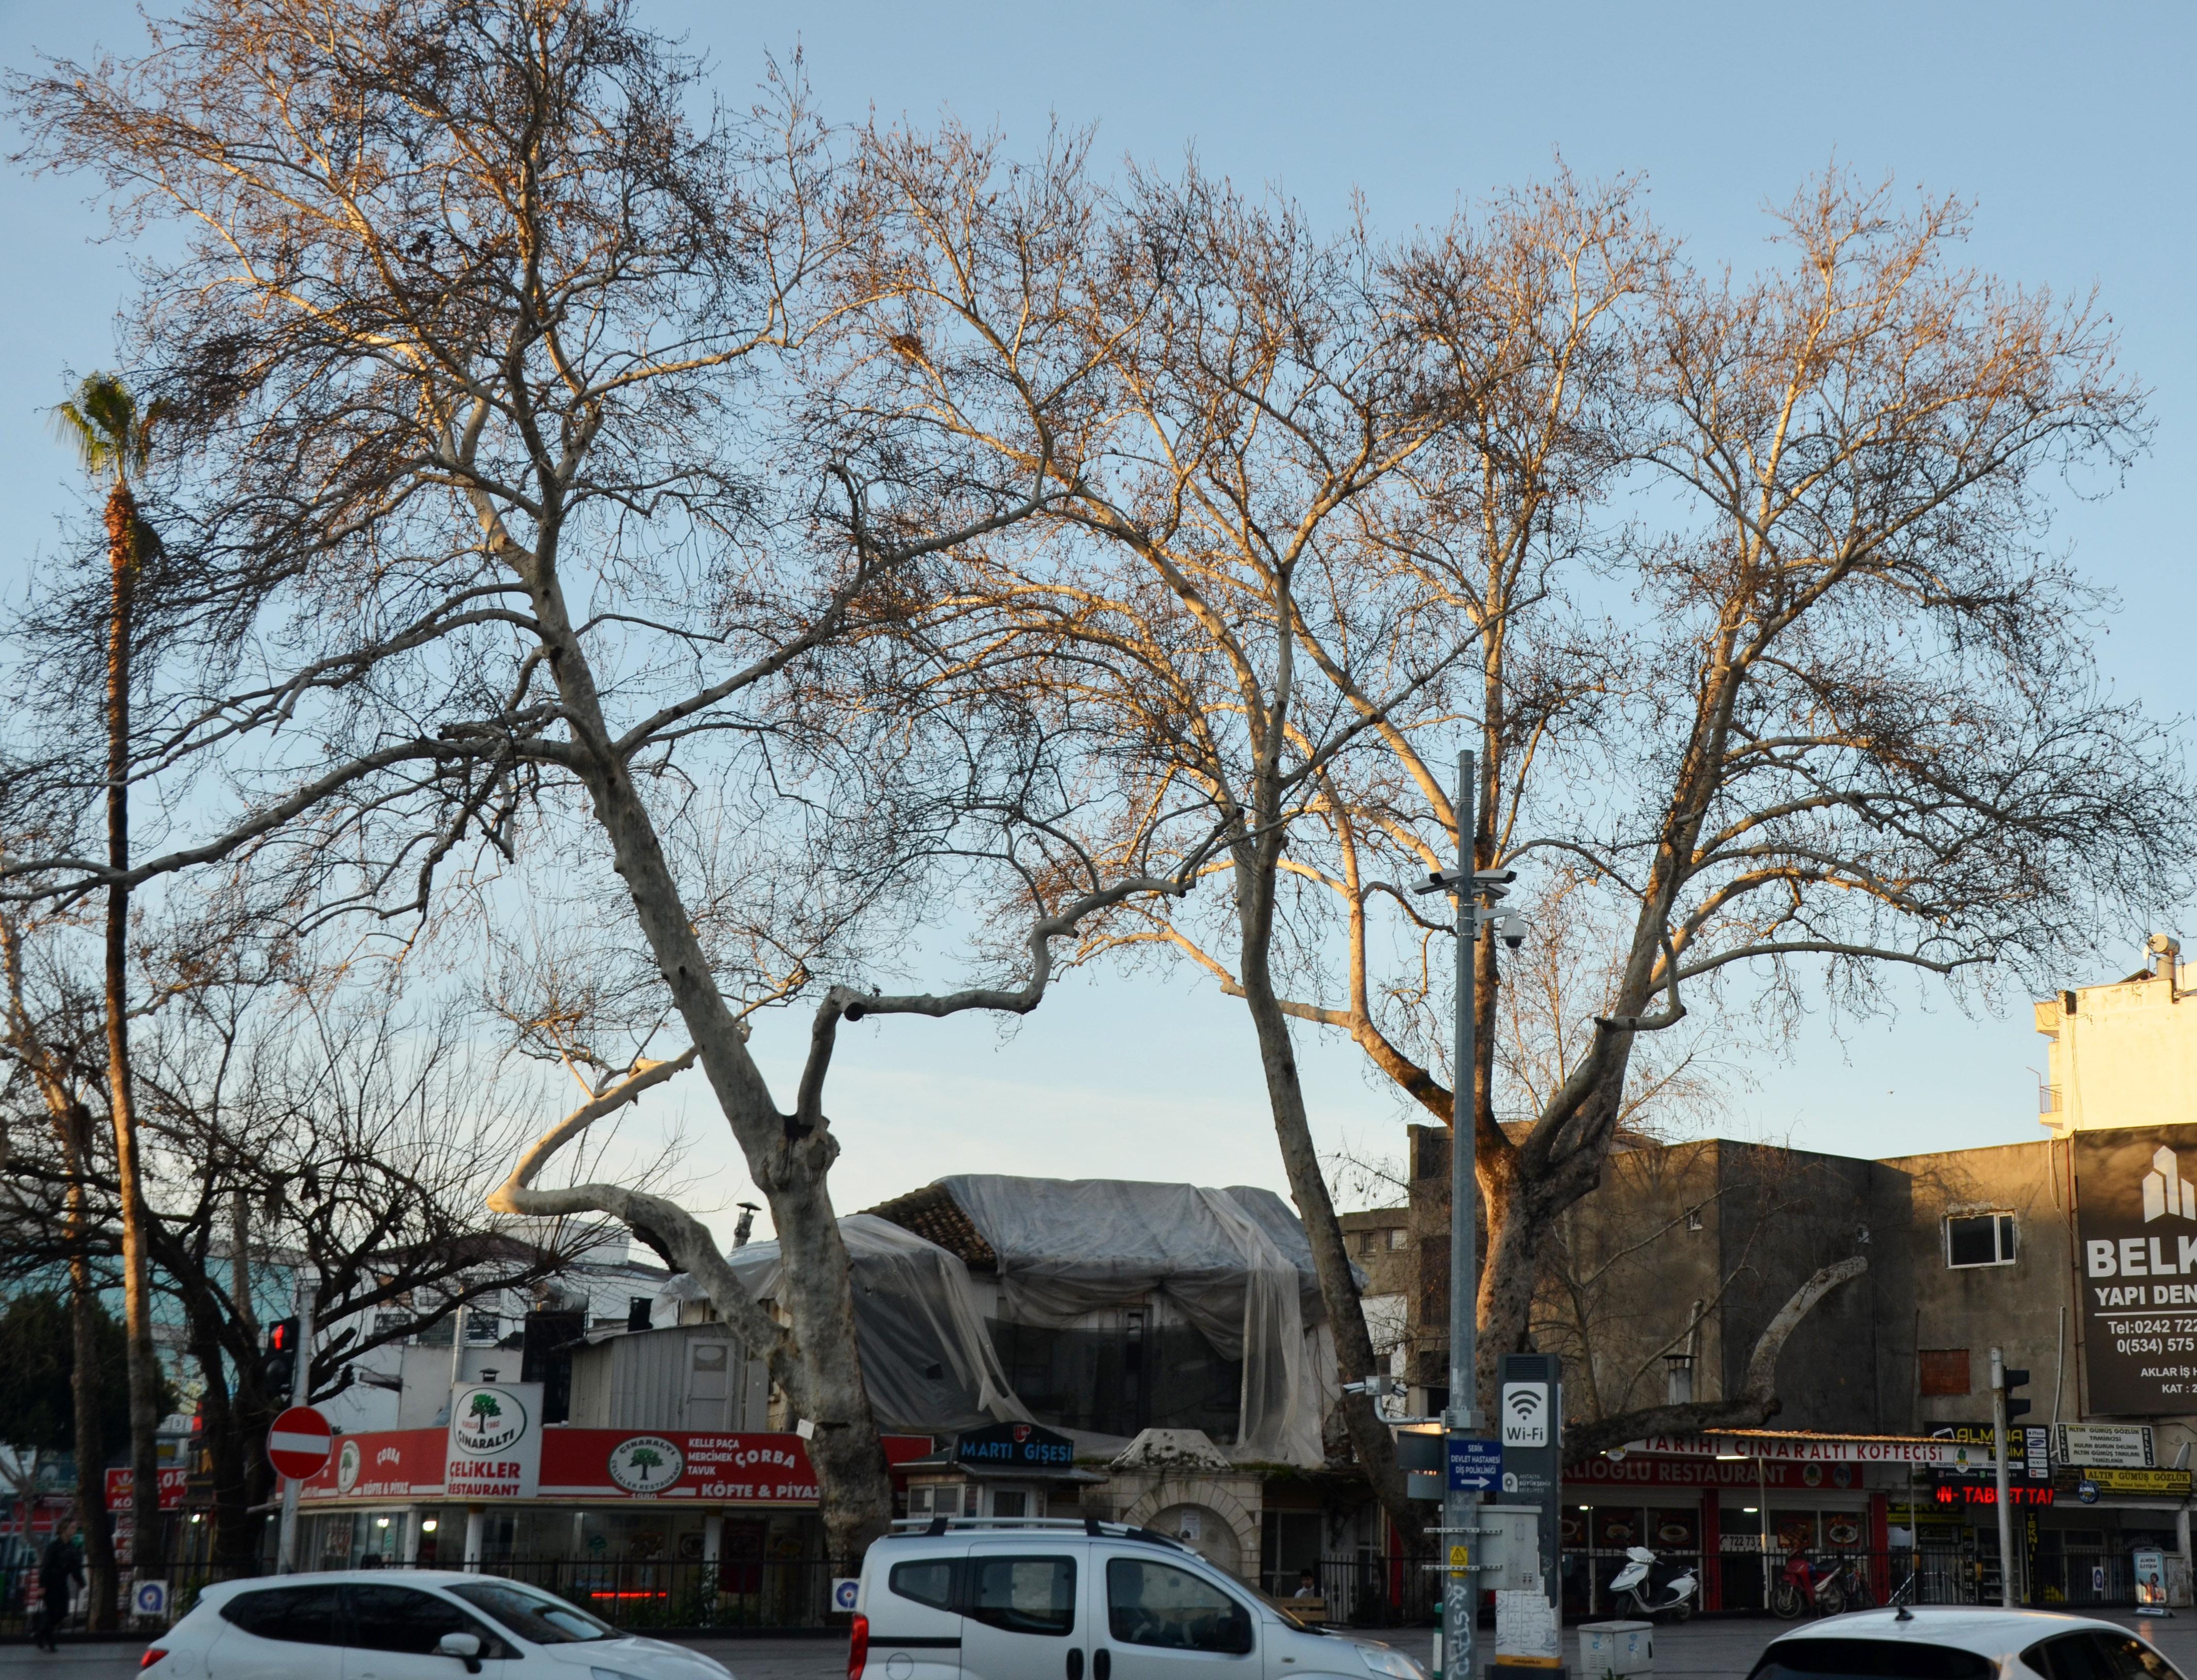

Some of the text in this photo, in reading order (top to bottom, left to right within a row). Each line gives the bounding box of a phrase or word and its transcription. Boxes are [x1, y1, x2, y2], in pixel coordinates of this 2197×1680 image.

[2087, 1235, 2197, 1277] BELK
[2095, 1285, 2197, 1306] YAPI DEN
[2107, 1320, 2171, 1334] Tel:0242
[2117, 1338, 2195, 1356] 0(534) 575
[2140, 1368, 2177, 1377] AKLAR
[2162, 1384, 2183, 1393] KAT
[1507, 1427, 1543, 1440] Wi-Fi
[1957, 1428, 2023, 1442] ALMA
[688, 1438, 740, 1451] KELLE PAÇA
[1468, 1443, 1484, 1452] SERİK
[688, 1449, 733, 1462] MERCİMEK
[961, 1439, 1072, 1464] MARTI GİŞESİ
[735, 1449, 796, 1468] ÇORBA
[1451, 1455, 1501, 1464] DEVLET HASTANESİ
[687, 1465, 716, 1476] TAVUK
[1659, 1463, 1787, 1484] RESTAURANT
[2088, 1471, 2188, 1482] ALTIN GÜMÜŞ GÖZLÜK
[448, 1483, 520, 1496] RESTAURANT
[701, 1480, 754, 1498] KÖFTE
[757, 1484, 771, 1498] &
[1730, 1536, 1743, 1546] 722
[1746, 1536, 1755, 1546] 73
